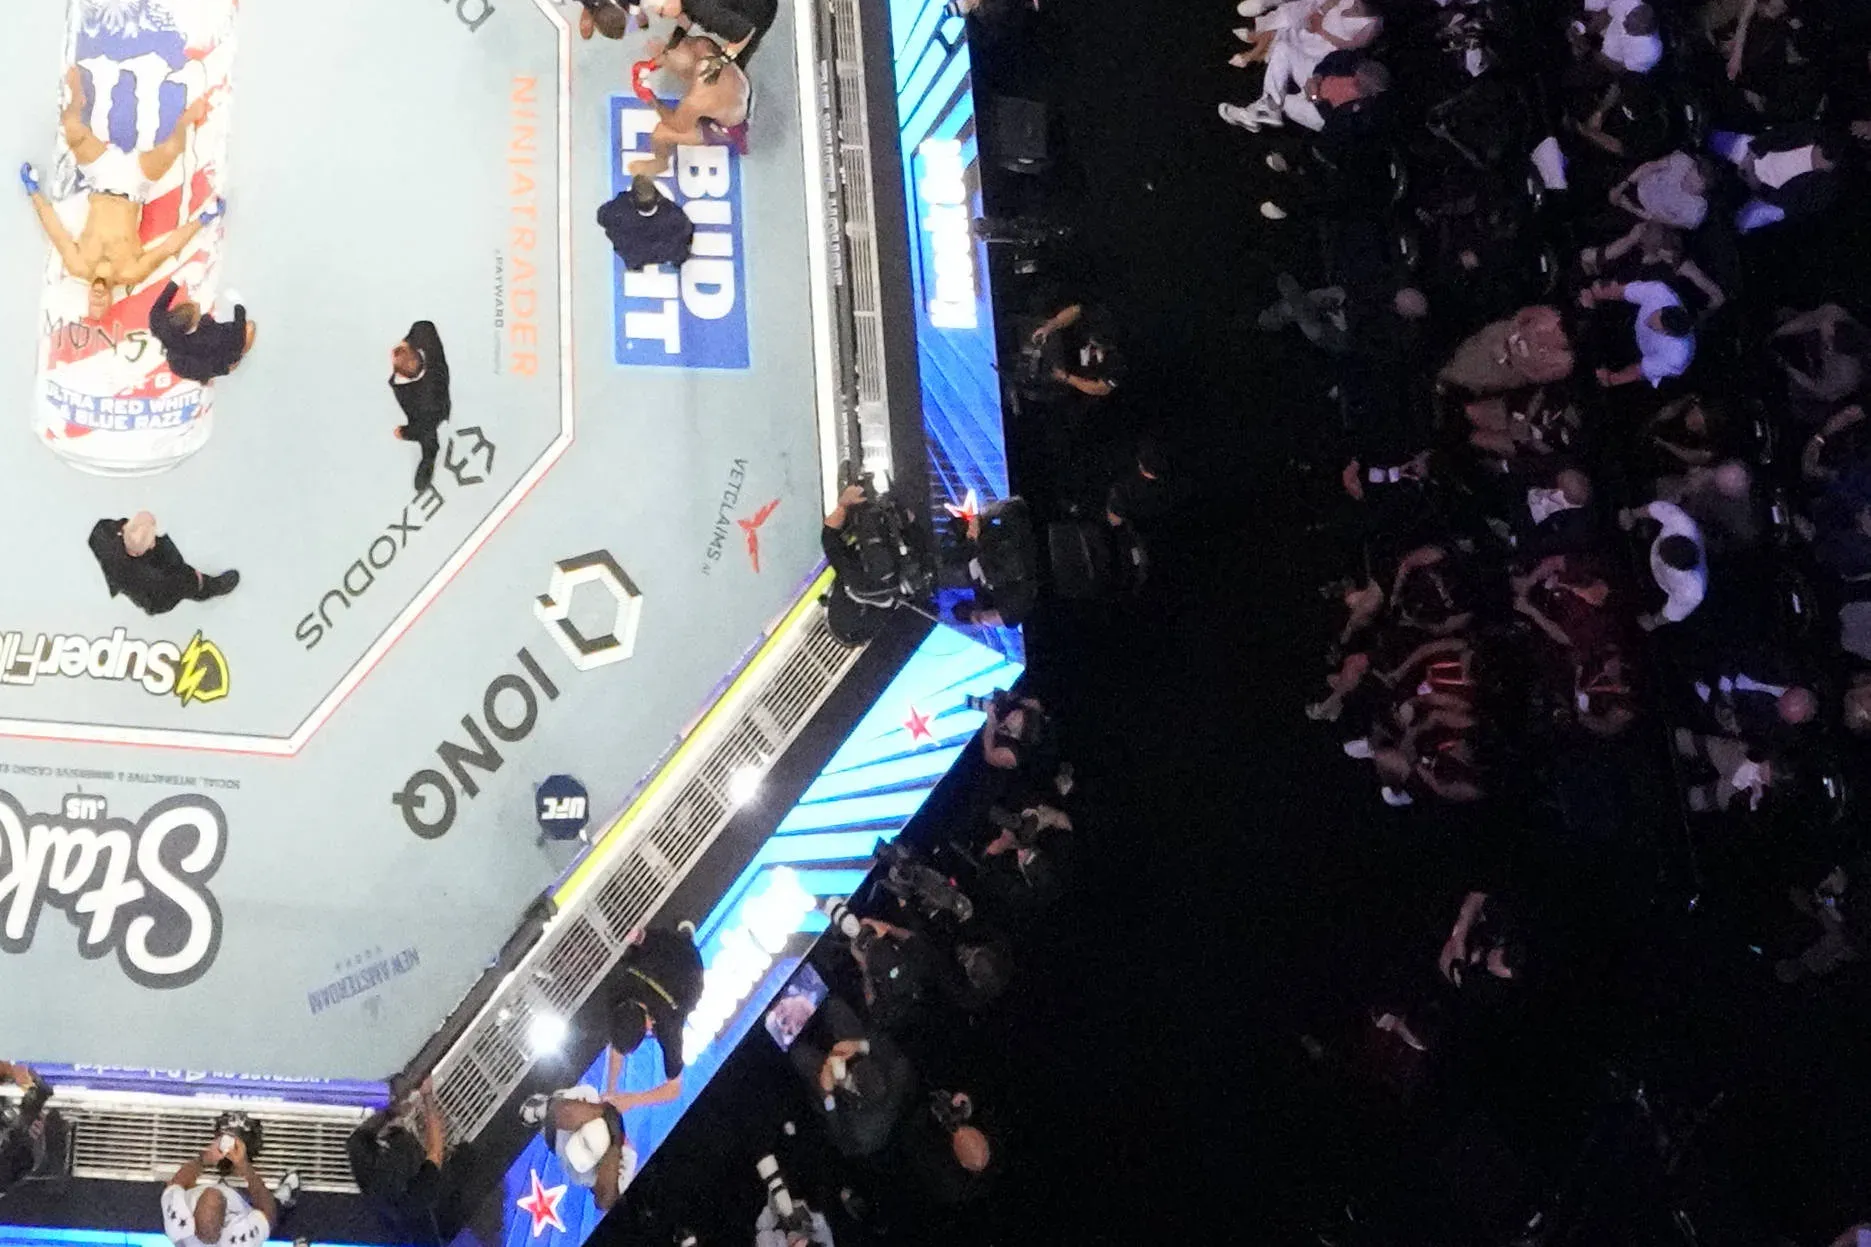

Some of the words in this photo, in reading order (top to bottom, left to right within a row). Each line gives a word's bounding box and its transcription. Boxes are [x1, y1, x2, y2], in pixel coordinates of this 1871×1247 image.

[508, 74, 539, 379] NINJATRADER
[678, 144, 735, 320] BUD
[494, 257, 505, 328] PAYWARD
[74, 410, 128, 430] BLUE
[134, 411, 181, 429] RAZZ
[99, 397, 144, 414] RED
[149, 390, 201, 413] WHITE
[708, 457, 748, 561] VETCLAIMS
[295, 488, 445, 652] EXODUS
[392, 647, 559, 840] IONQ
[540, 795, 585, 819] UFC
[309, 961, 390, 1013] AMSTERDAM
[393, 948, 419, 973] NEW
